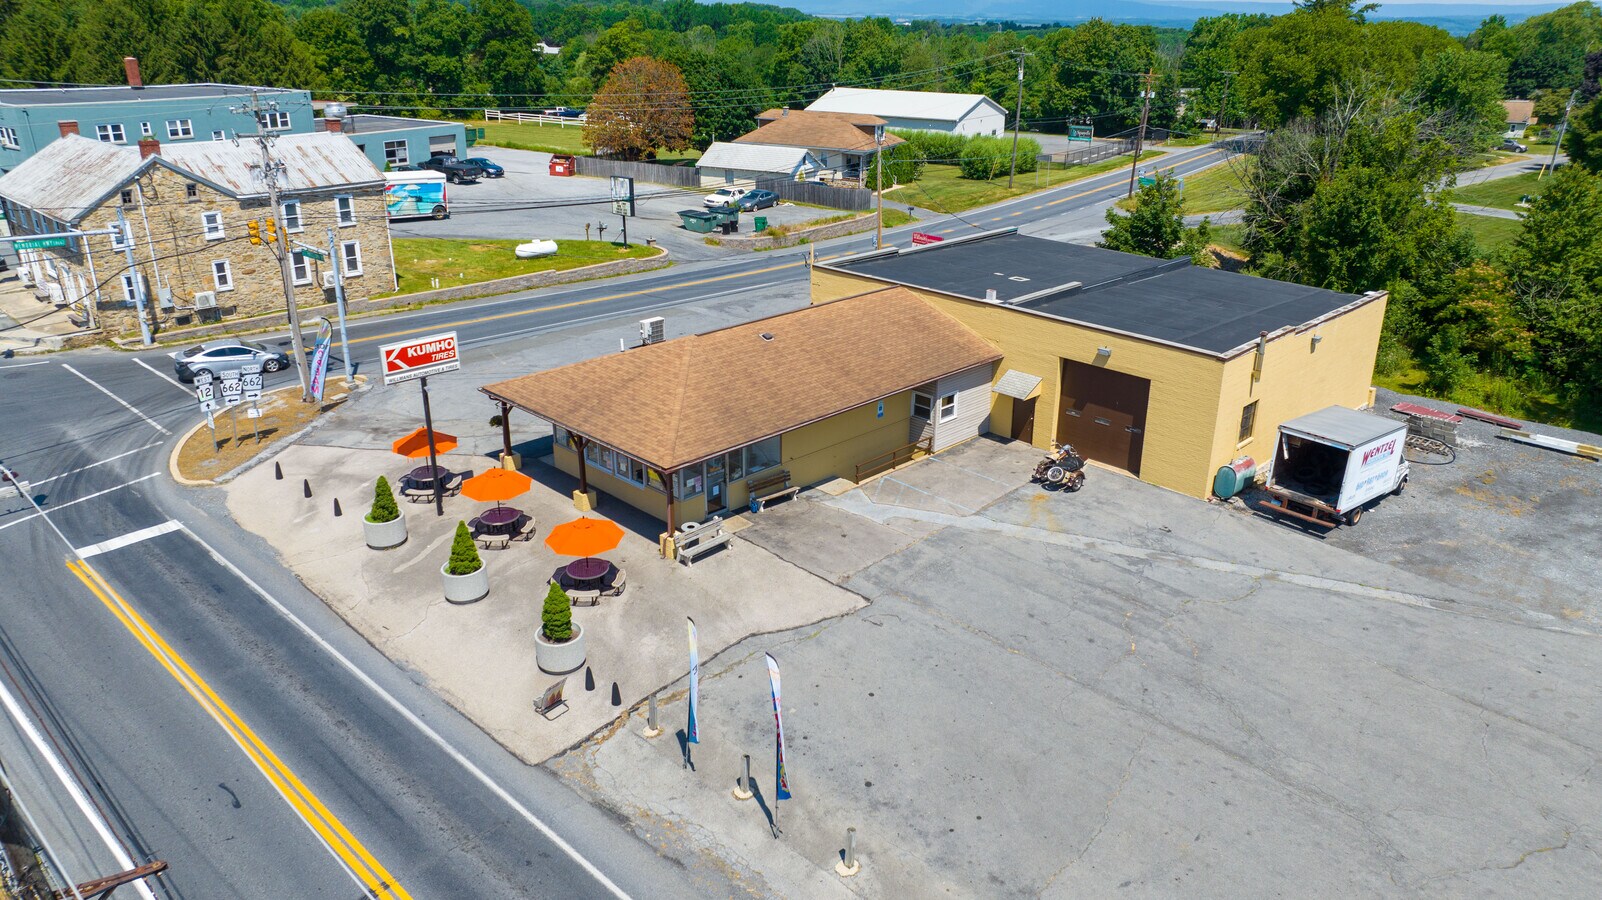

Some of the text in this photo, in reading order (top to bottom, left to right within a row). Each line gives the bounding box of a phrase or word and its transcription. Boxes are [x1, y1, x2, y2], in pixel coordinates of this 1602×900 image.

[407, 339, 454, 358] KUMHO
[431, 350, 455, 361] TIRES
[221, 370, 239, 378] SOUTH
[413, 367, 440, 378] AUTOMOTIVE
[222, 382, 241, 392] 662
[243, 377, 261, 387] 662
[200, 387, 212, 398] 12
[1361, 438, 1396, 467] WENTZEL
